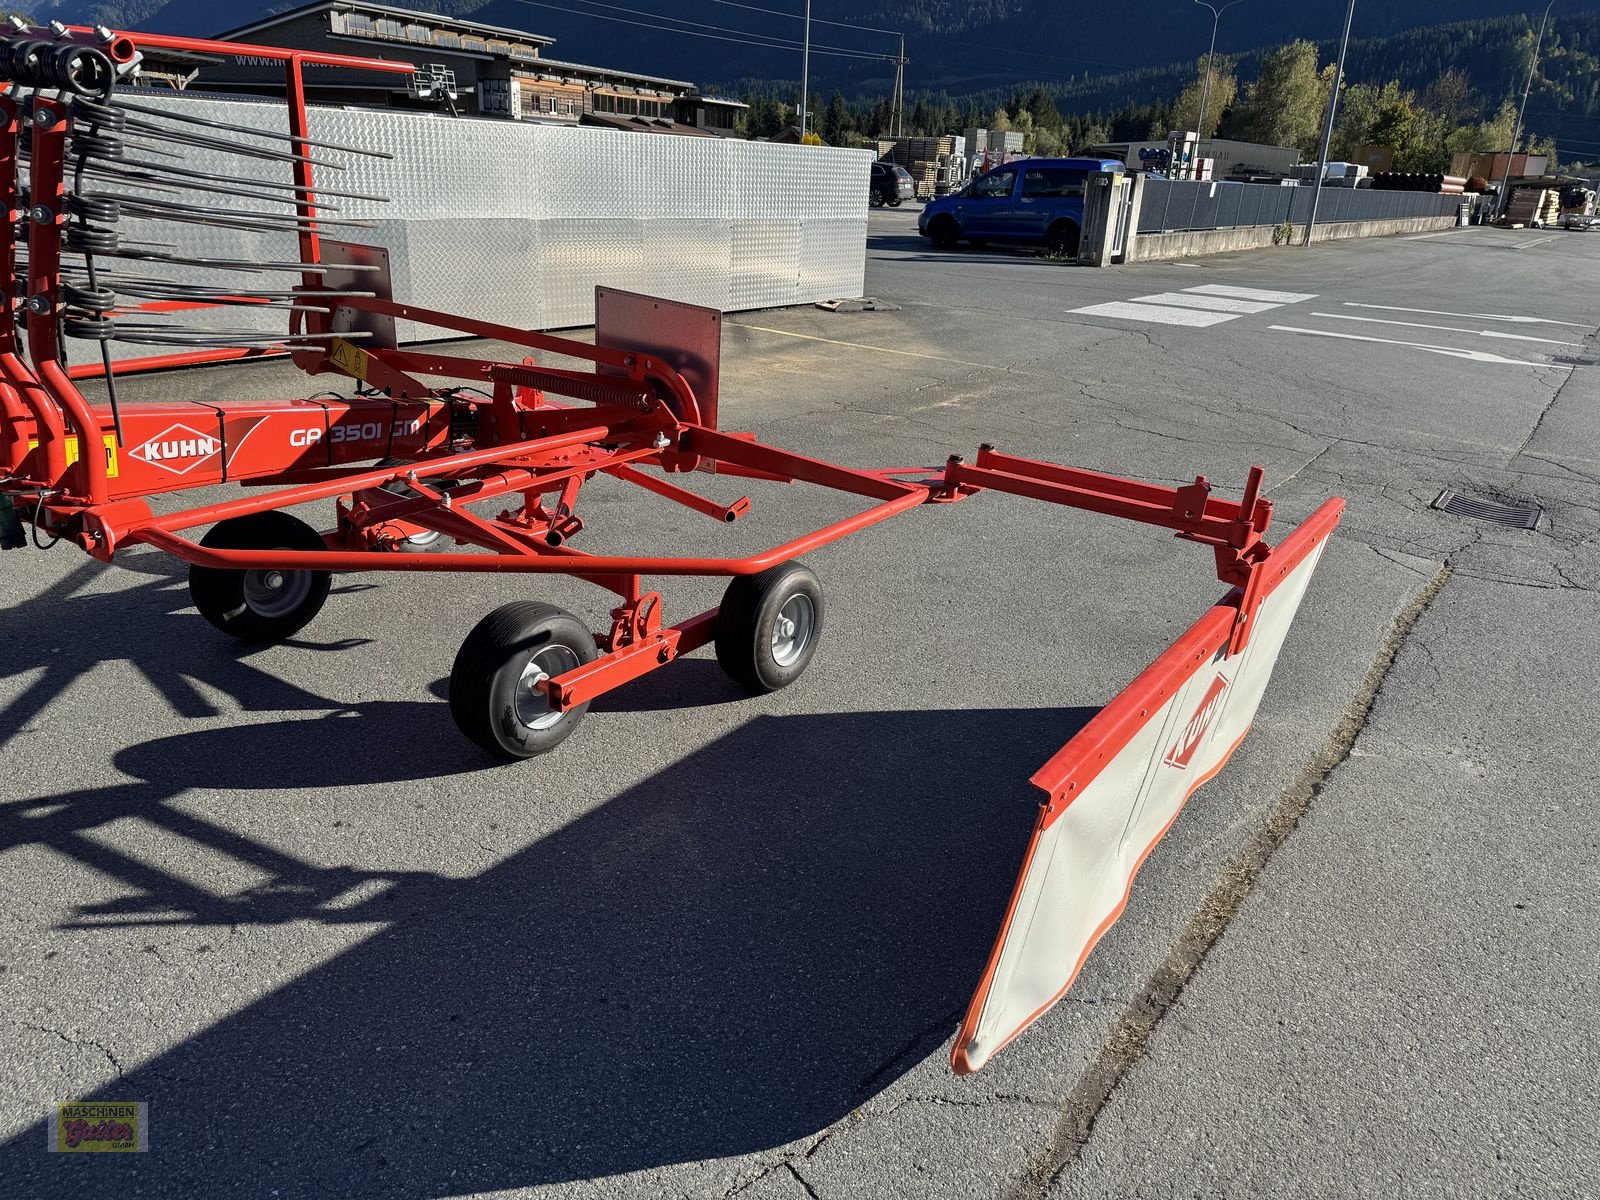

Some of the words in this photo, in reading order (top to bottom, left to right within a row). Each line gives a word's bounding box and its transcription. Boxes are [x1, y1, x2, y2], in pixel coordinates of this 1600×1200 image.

[290, 428, 322, 447] GA
[331, 423, 382, 443] 3501
[390, 420, 420, 437] GM
[144, 438, 214, 461] KUHN
